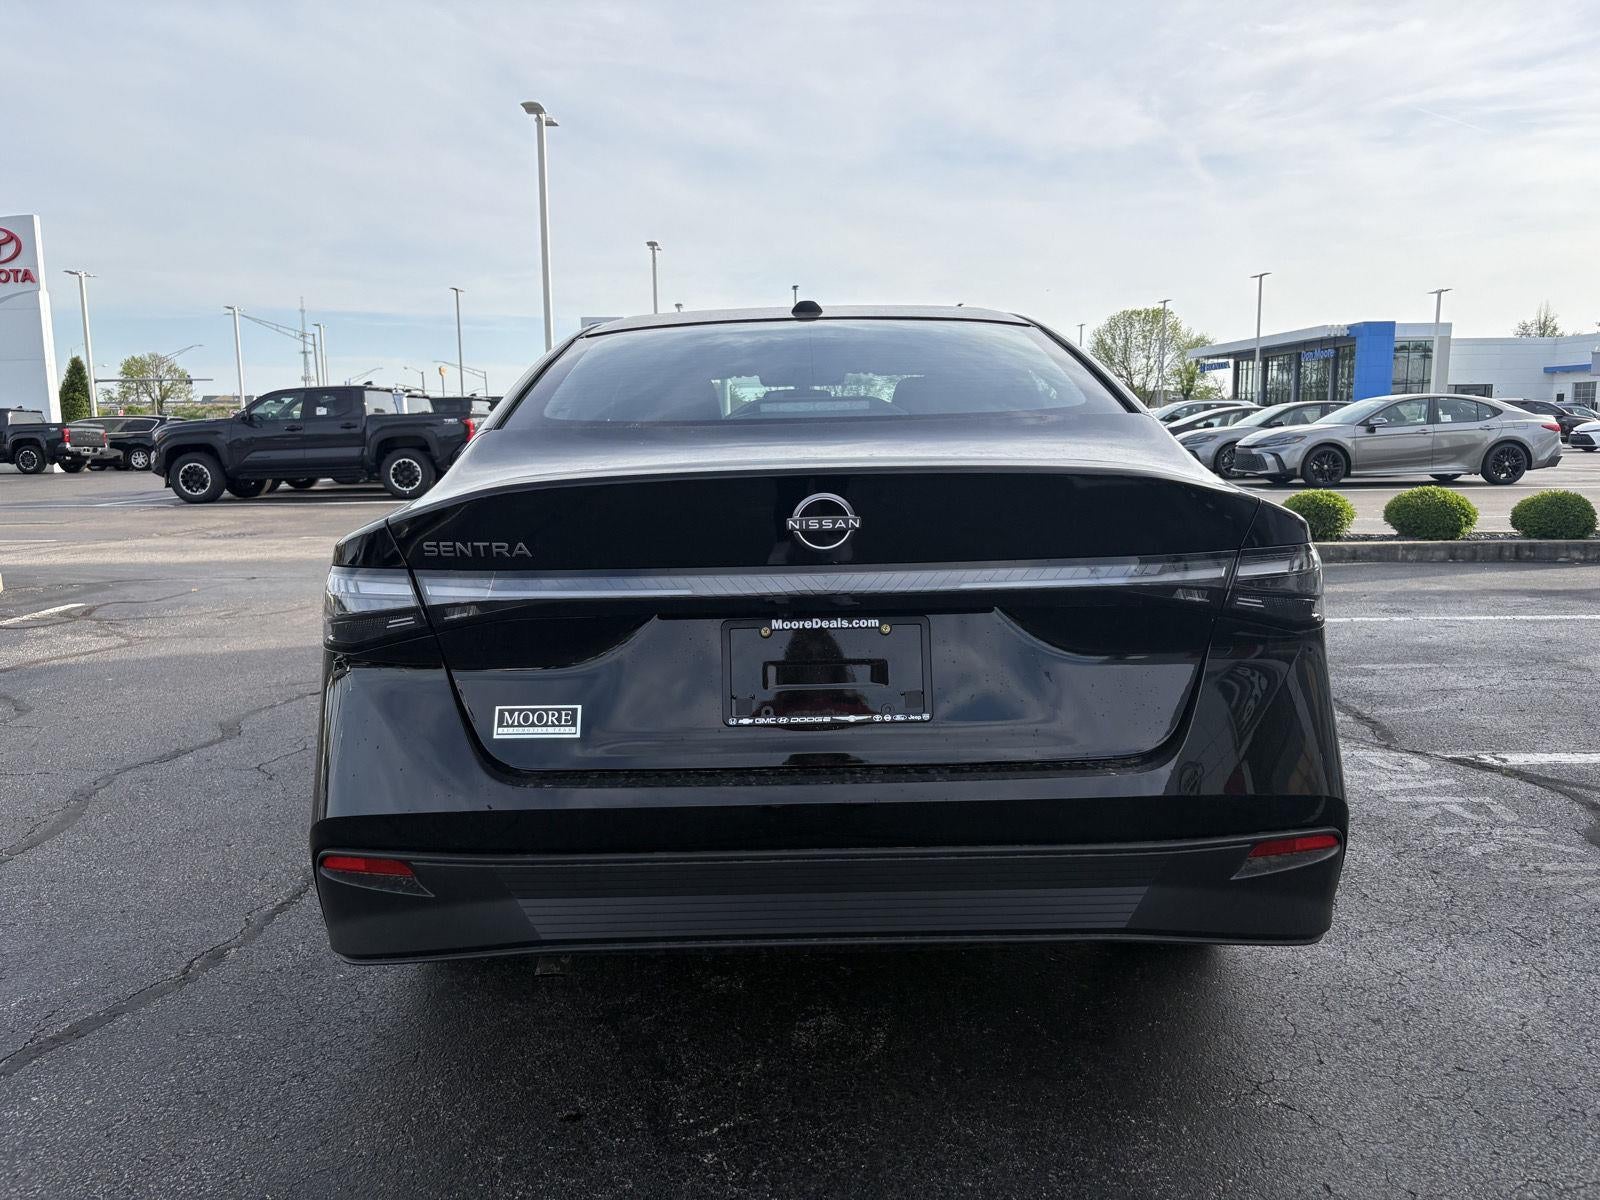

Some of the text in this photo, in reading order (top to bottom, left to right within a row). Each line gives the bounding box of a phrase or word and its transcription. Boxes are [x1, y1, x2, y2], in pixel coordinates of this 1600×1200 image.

[1313, 348, 1334, 359] Moore
[788, 518, 860, 530] NISSAN
[422, 541, 533, 557] SENTRA
[771, 618, 879, 629] MooreDeals.com
[502, 710, 572, 726] MOORE
